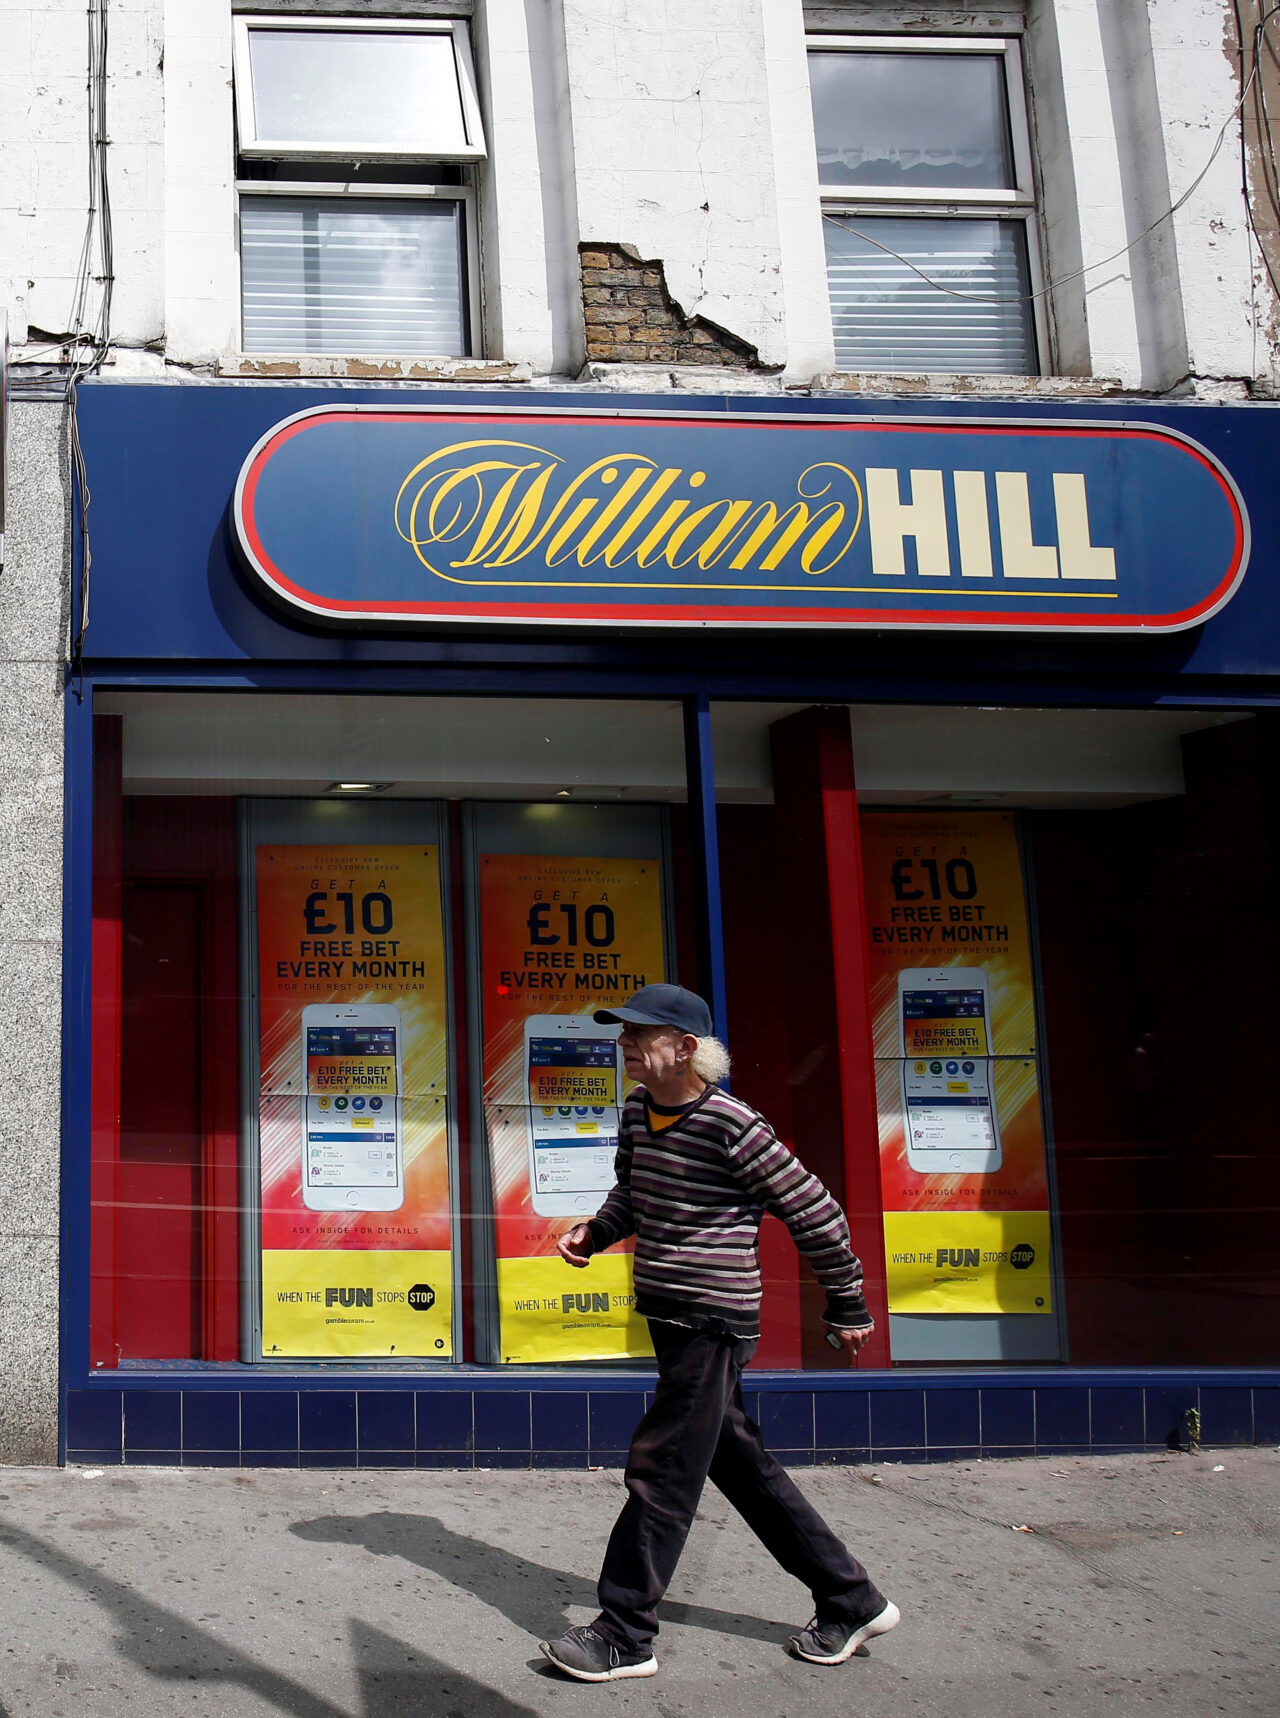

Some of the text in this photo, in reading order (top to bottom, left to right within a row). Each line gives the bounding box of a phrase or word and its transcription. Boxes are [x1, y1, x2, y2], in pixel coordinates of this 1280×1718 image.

[394, 439, 1117, 580] William HILL
[896, 846, 968, 857] GET A
[310, 880, 386, 890] GET A
[890, 858, 978, 900] £10
[534, 890, 608, 902] GET A
[303, 892, 393, 935] £10
[891, 906, 986, 922] FREE BET
[527, 903, 615, 947] £10
[872, 925, 1008, 943] EVERY MONTH
[300, 941, 400, 957] FREE BET
[524, 952, 621, 970] FREE BET
[277, 961, 425, 978] EVERY MONTH
[278, 983, 425, 991] FOR THE REST OF THE YEAR
[500, 971, 646, 990] EVERY MONTH
[935, 1028, 956, 1037] FREE
[959, 1028, 976, 1036] BET
[914, 1038, 979, 1047] EVERY MONTH
[318, 1066, 386, 1075] £10 FREE BET
[317, 1076, 388, 1085] EVERY MONTH
[560, 1077, 584, 1086] FREE
[588, 1078, 606, 1086] BET
[539, 1087, 607, 1096] EVERY MONTH
[892, 1249, 1033, 1267] WHEN THE FUN STOPS STOP
[277, 1288, 434, 1308] WHEN THE FUN STOPS STOP
[514, 1300, 540, 1311] WHEN
[542, 1299, 558, 1310] THE
[562, 1293, 610, 1313] FUN
